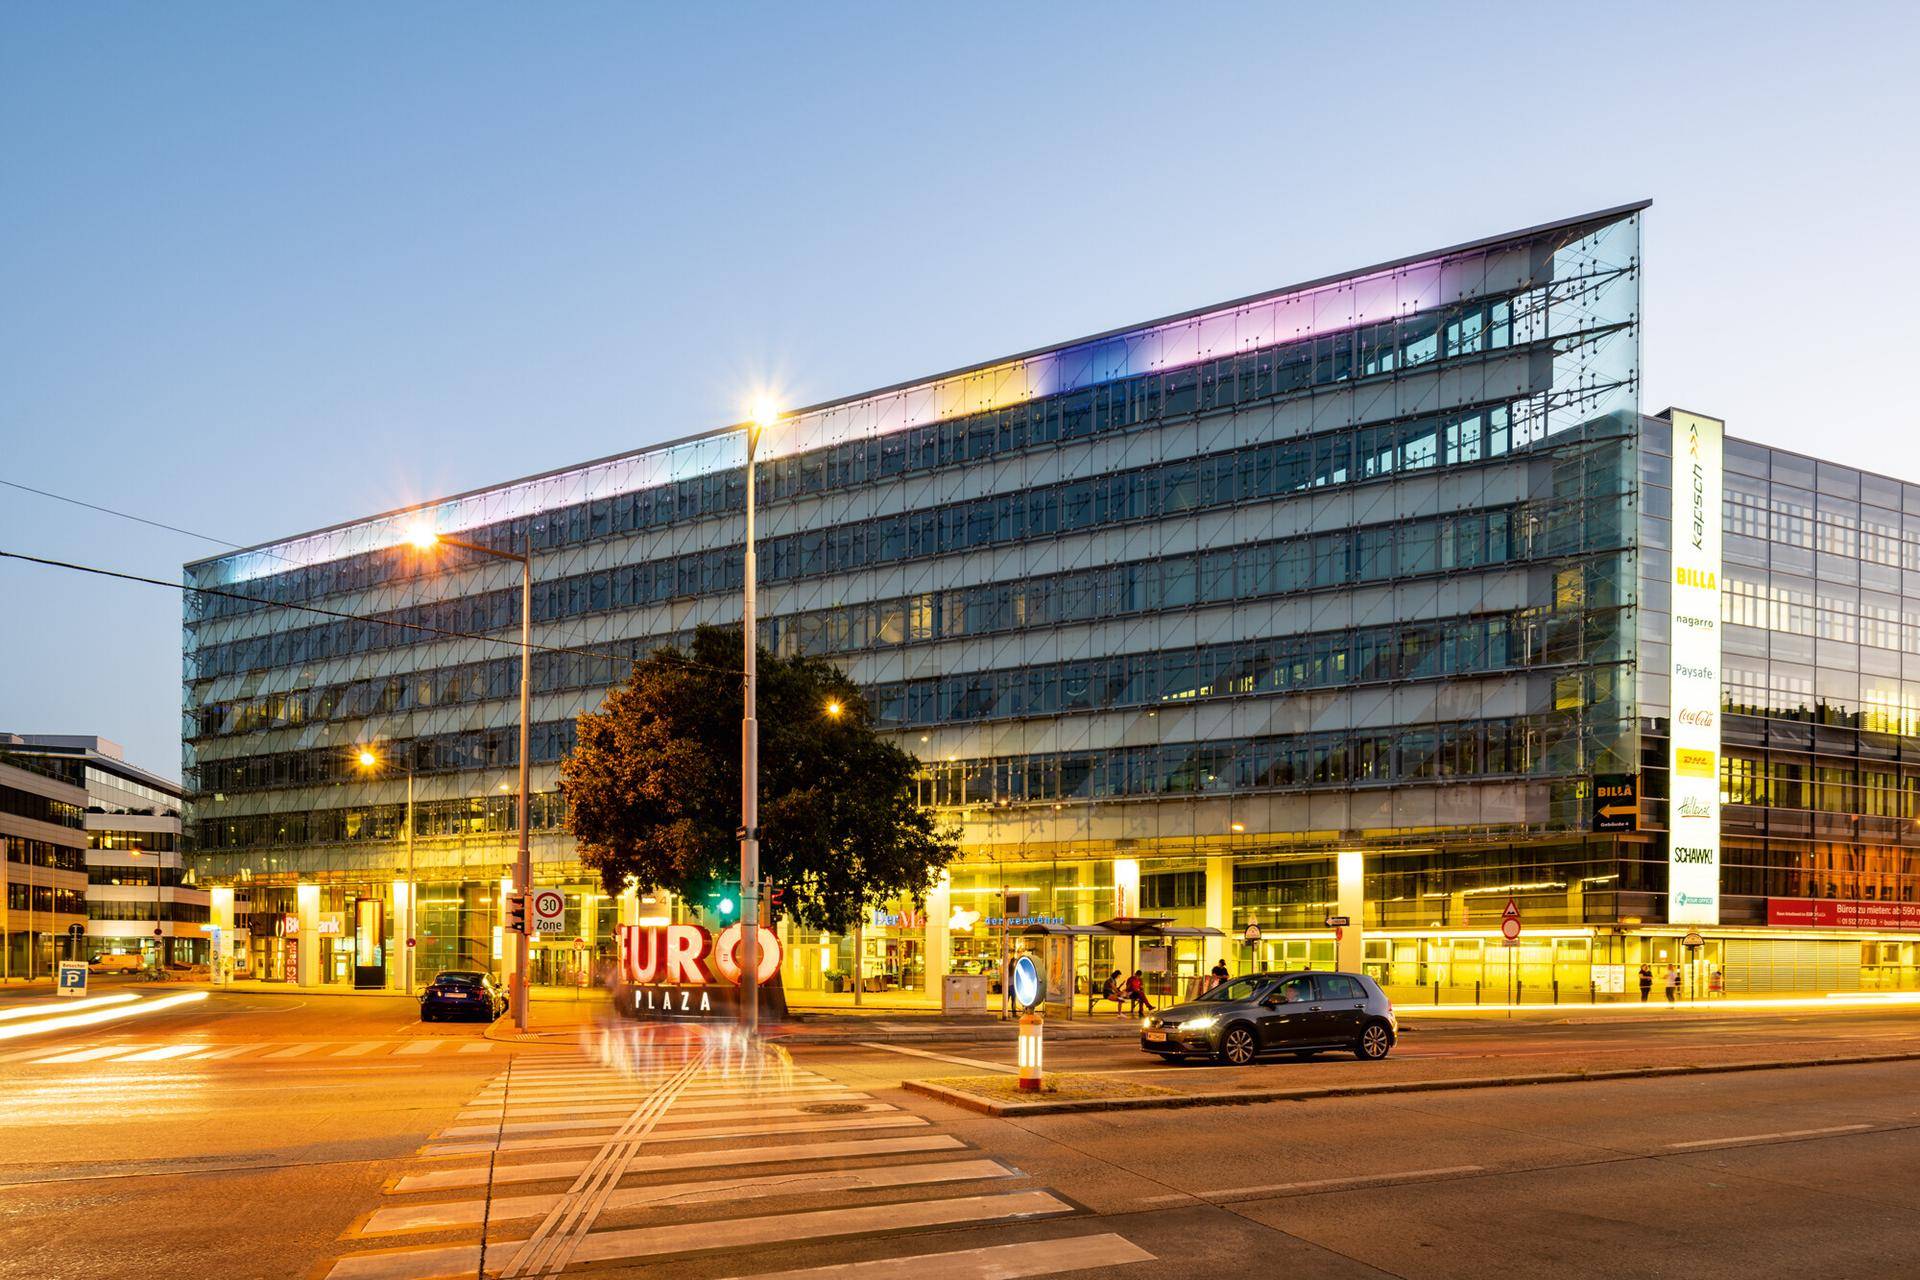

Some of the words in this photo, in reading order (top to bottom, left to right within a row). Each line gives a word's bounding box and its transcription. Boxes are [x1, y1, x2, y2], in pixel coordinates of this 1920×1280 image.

[1677, 567, 1716, 590] BILLA
[1676, 615, 1714, 628] nagarro
[1676, 663, 1713, 680] Paysafe
[1597, 785, 1632, 797] BILLA
[1675, 847, 1713, 865] SCHAWK!
[542, 899, 557, 912] 30
[1836, 904, 1857, 914] Büros
[1902, 906, 1916, 915] 590
[318, 915, 340, 933] ank
[537, 919, 562, 930] Zone
[286, 941, 297, 966] Bank
[66, 974, 79, 987] P
[635, 990, 711, 1011] PLAZA
